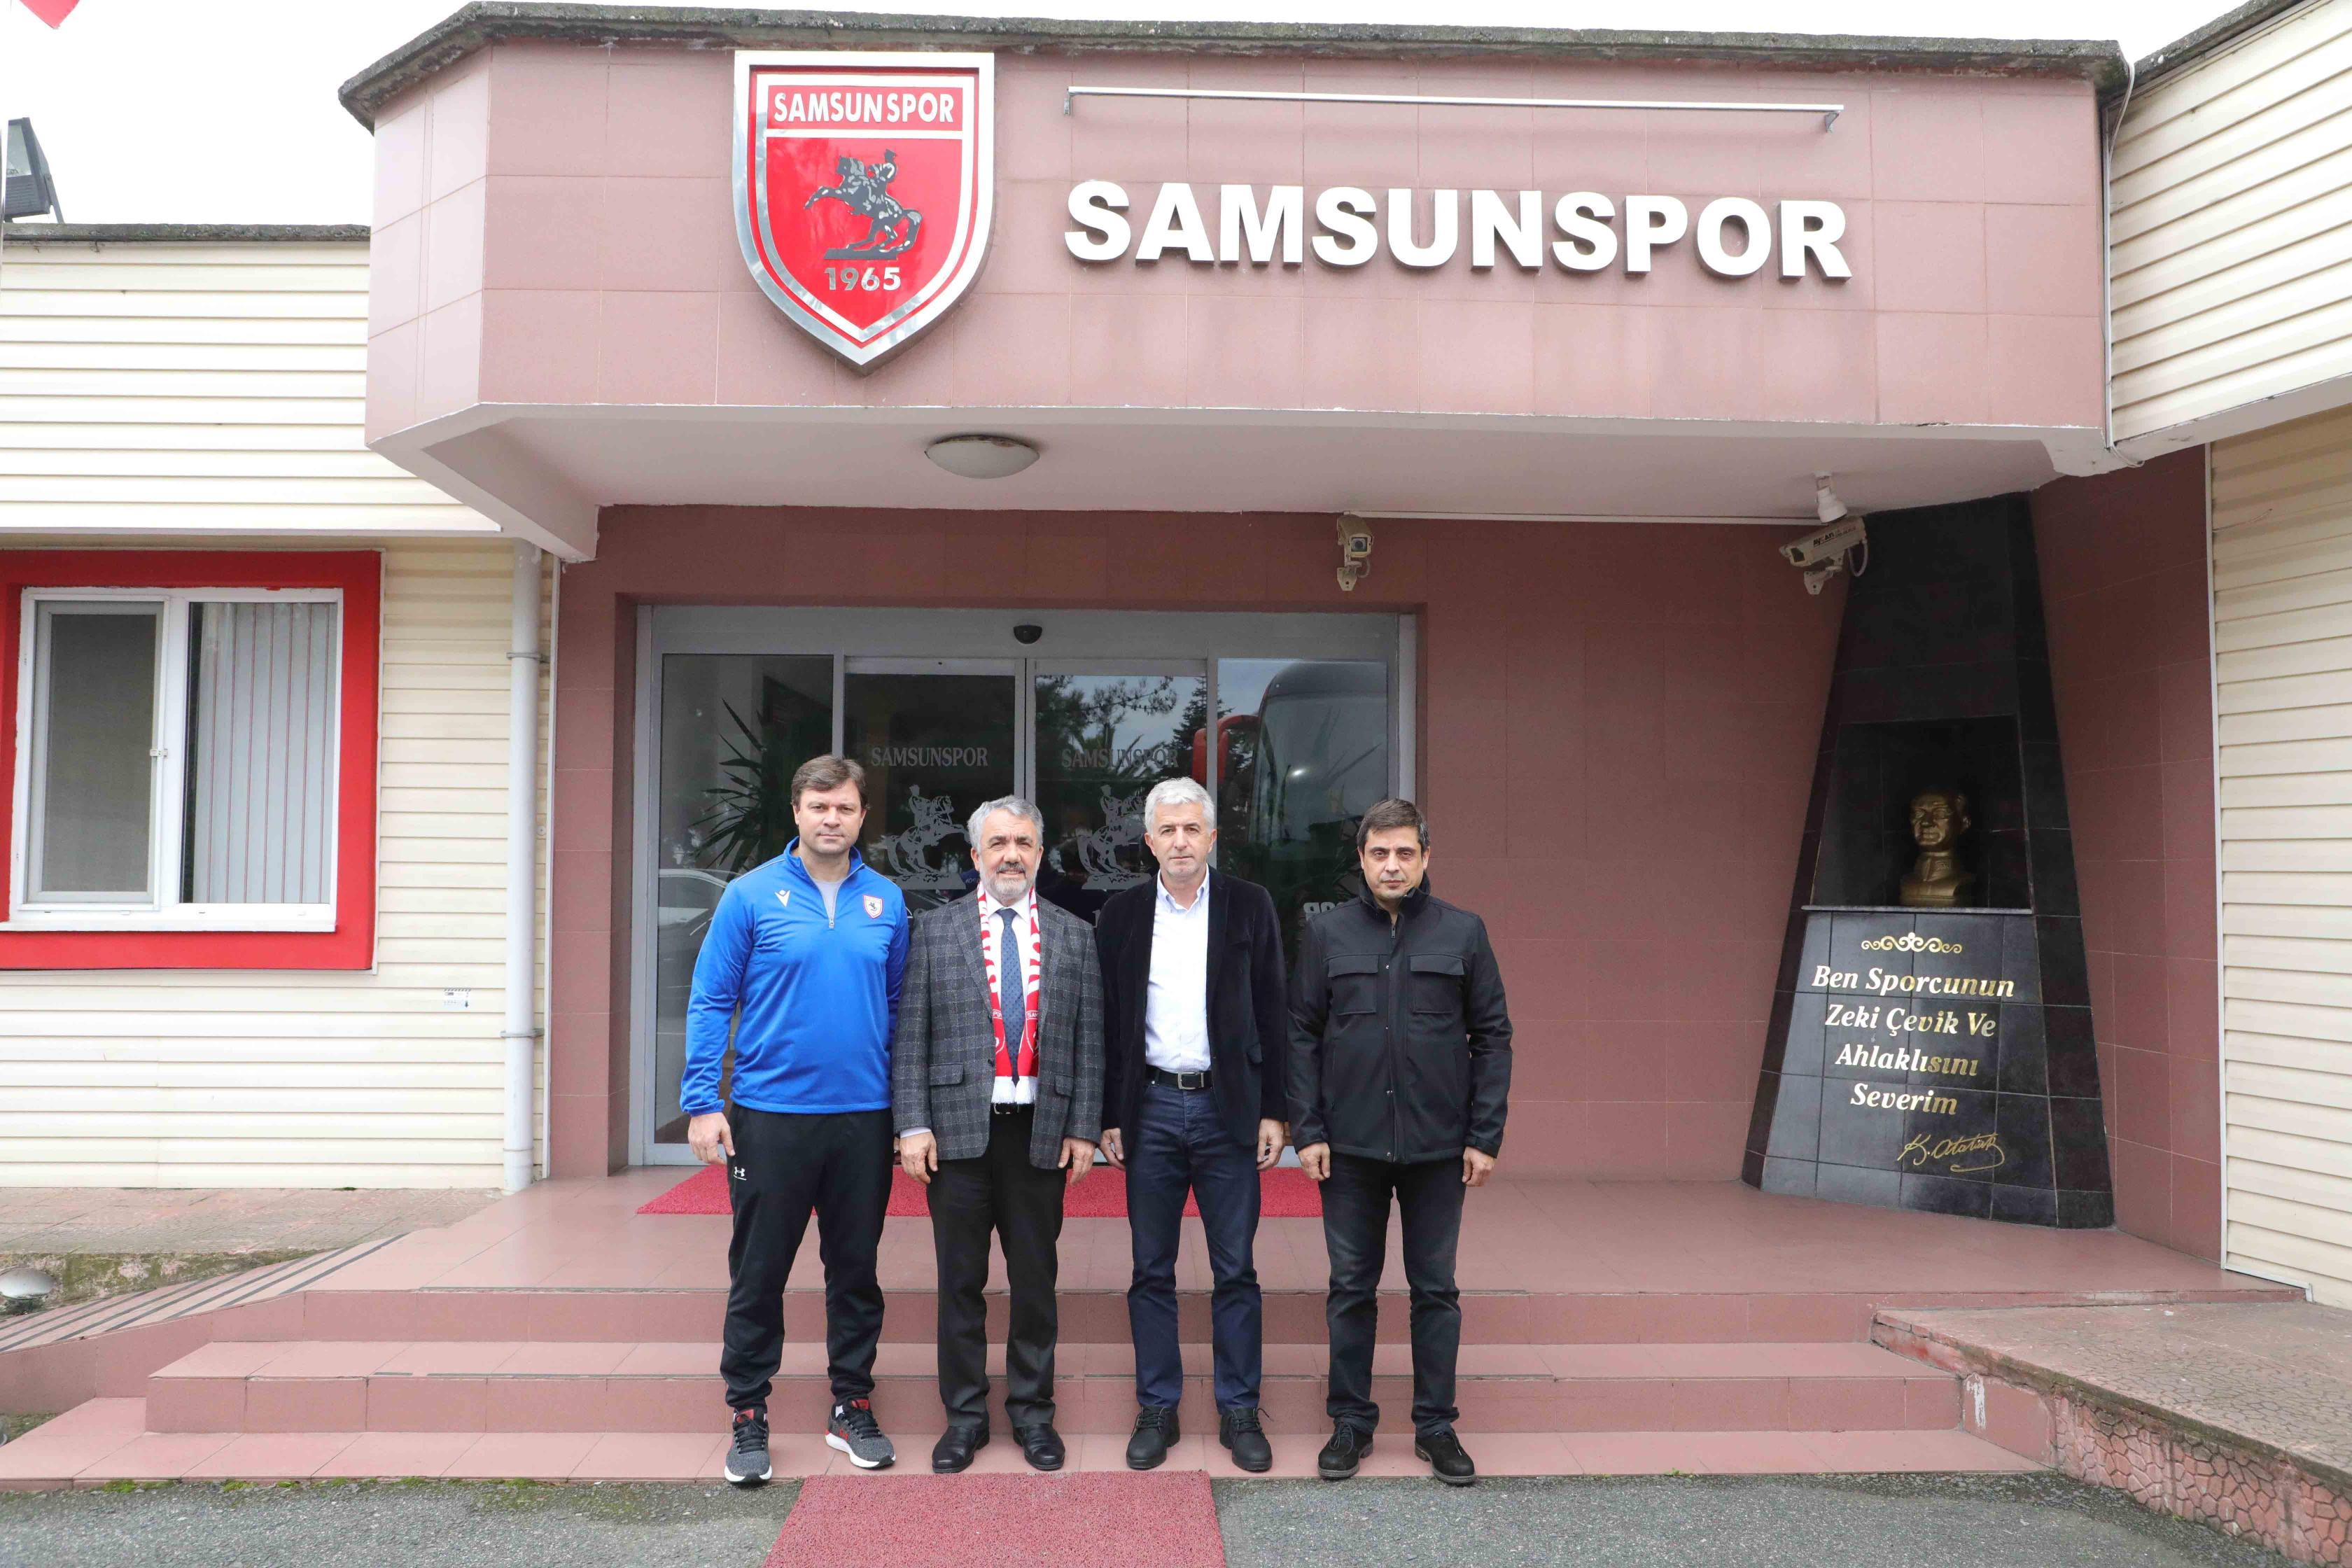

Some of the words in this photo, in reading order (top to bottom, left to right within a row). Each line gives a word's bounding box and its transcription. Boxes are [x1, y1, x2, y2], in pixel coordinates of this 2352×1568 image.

[774, 92, 954, 123] SAMSUNSPOR
[1064, 179, 1853, 282] SAMSUNSPOR
[823, 267, 902, 291] 1965
[871, 746, 988, 767] SAMSUNSPOR
[1060, 748, 1180, 769] SAMSUNSPOR
[1811, 965, 1859, 989] Ben
[1865, 967, 2015, 997] Sporcunun
[1824, 1003, 1880, 1029] Zeki
[1885, 1007, 1959, 1037] Çevik
[1967, 1011, 1996, 1037] Ve
[1835, 1043, 1978, 1077] Ahlaklısını
[1850, 1082, 1957, 1115] Severim
